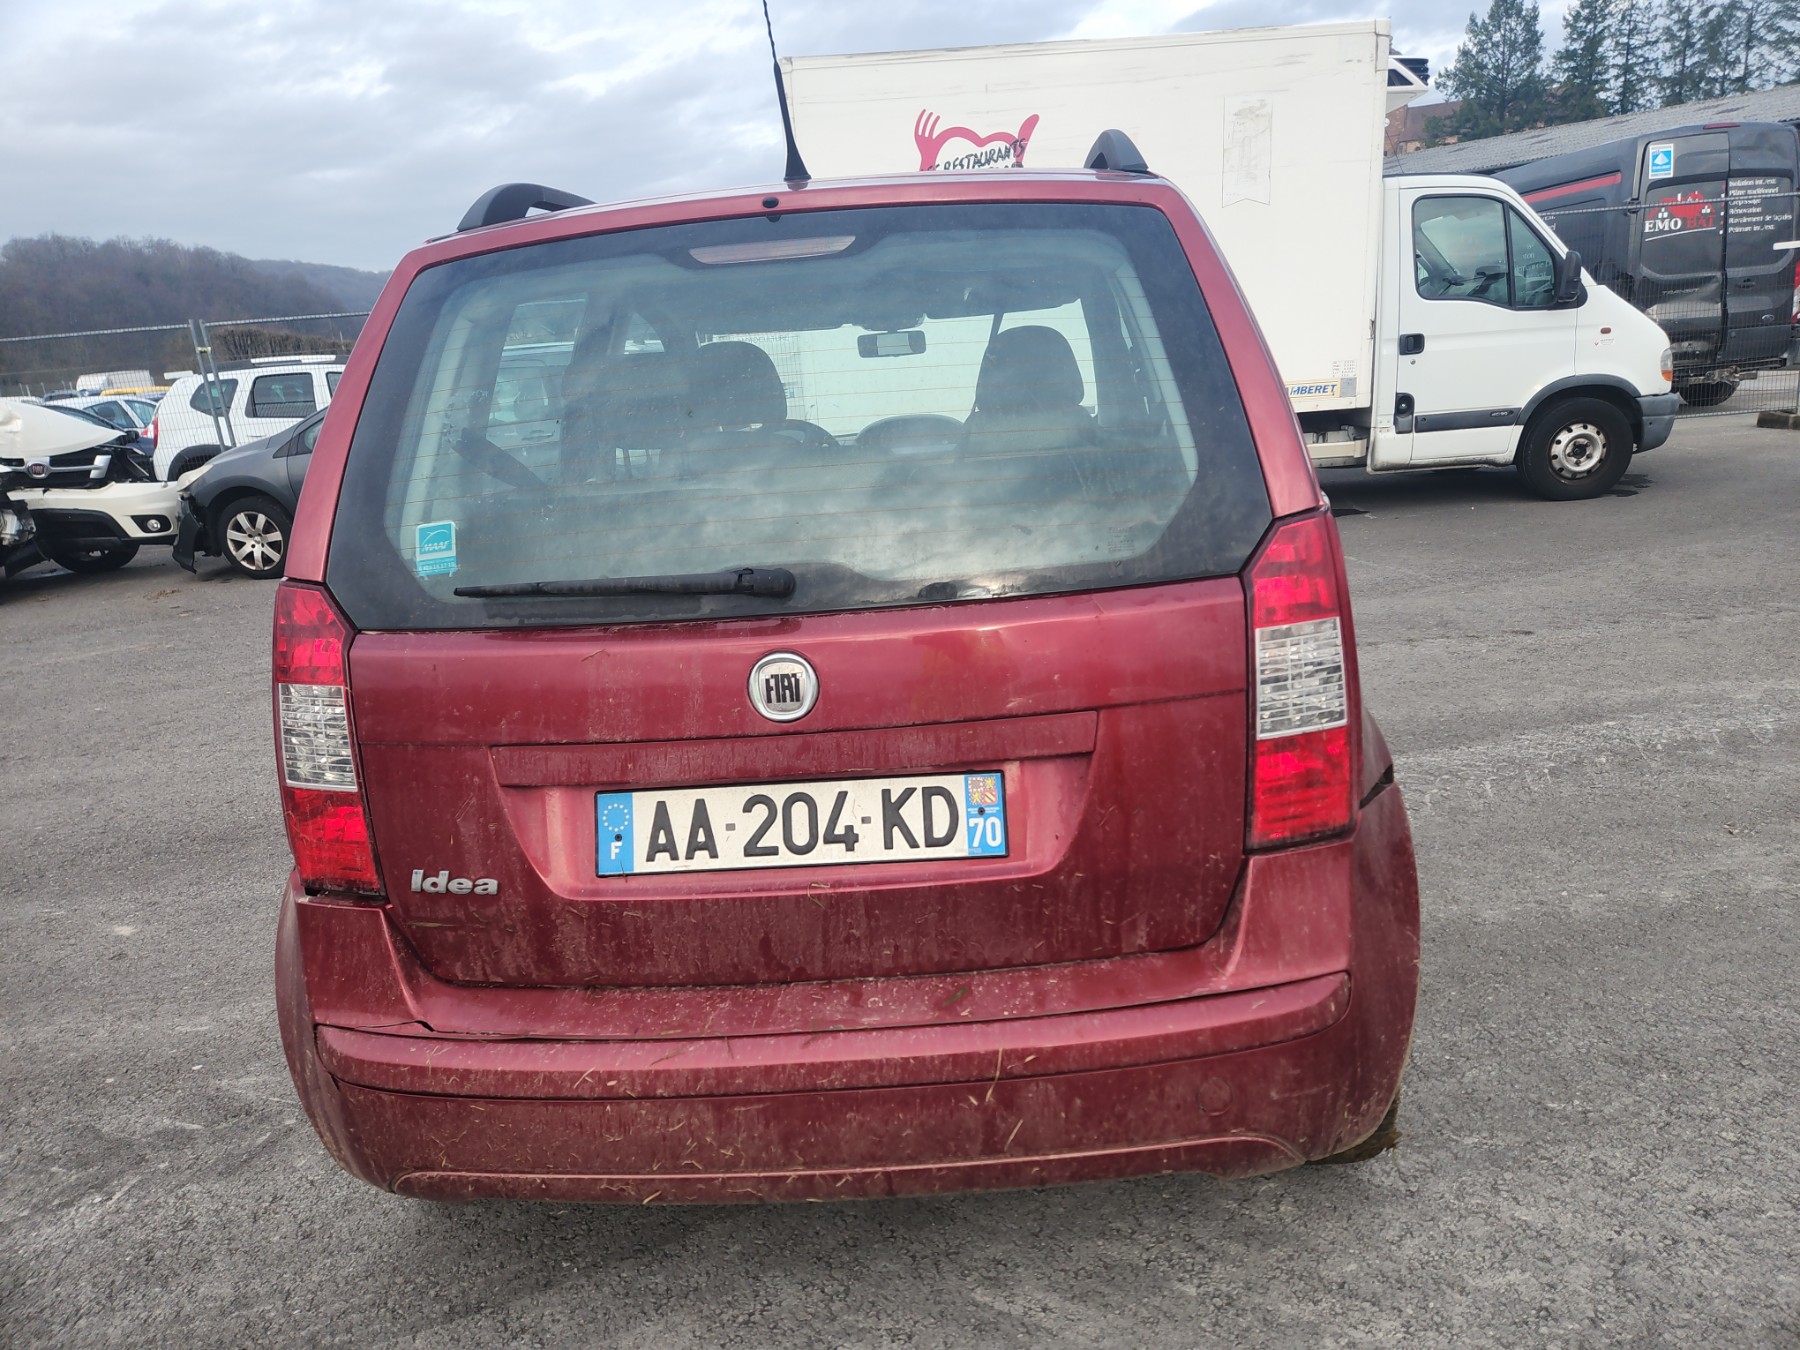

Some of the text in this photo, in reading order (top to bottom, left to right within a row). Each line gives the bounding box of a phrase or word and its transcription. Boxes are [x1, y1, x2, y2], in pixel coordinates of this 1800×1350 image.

[944, 138, 1026, 170] RESTAURANTS
[1644, 218, 1682, 233] EMO
[765, 672, 802, 704] FIAT
[646, 785, 960, 863] AA-204-KD
[969, 816, 1002, 848] 70
[610, 842, 622, 860] F
[411, 869, 498, 894] Idea
